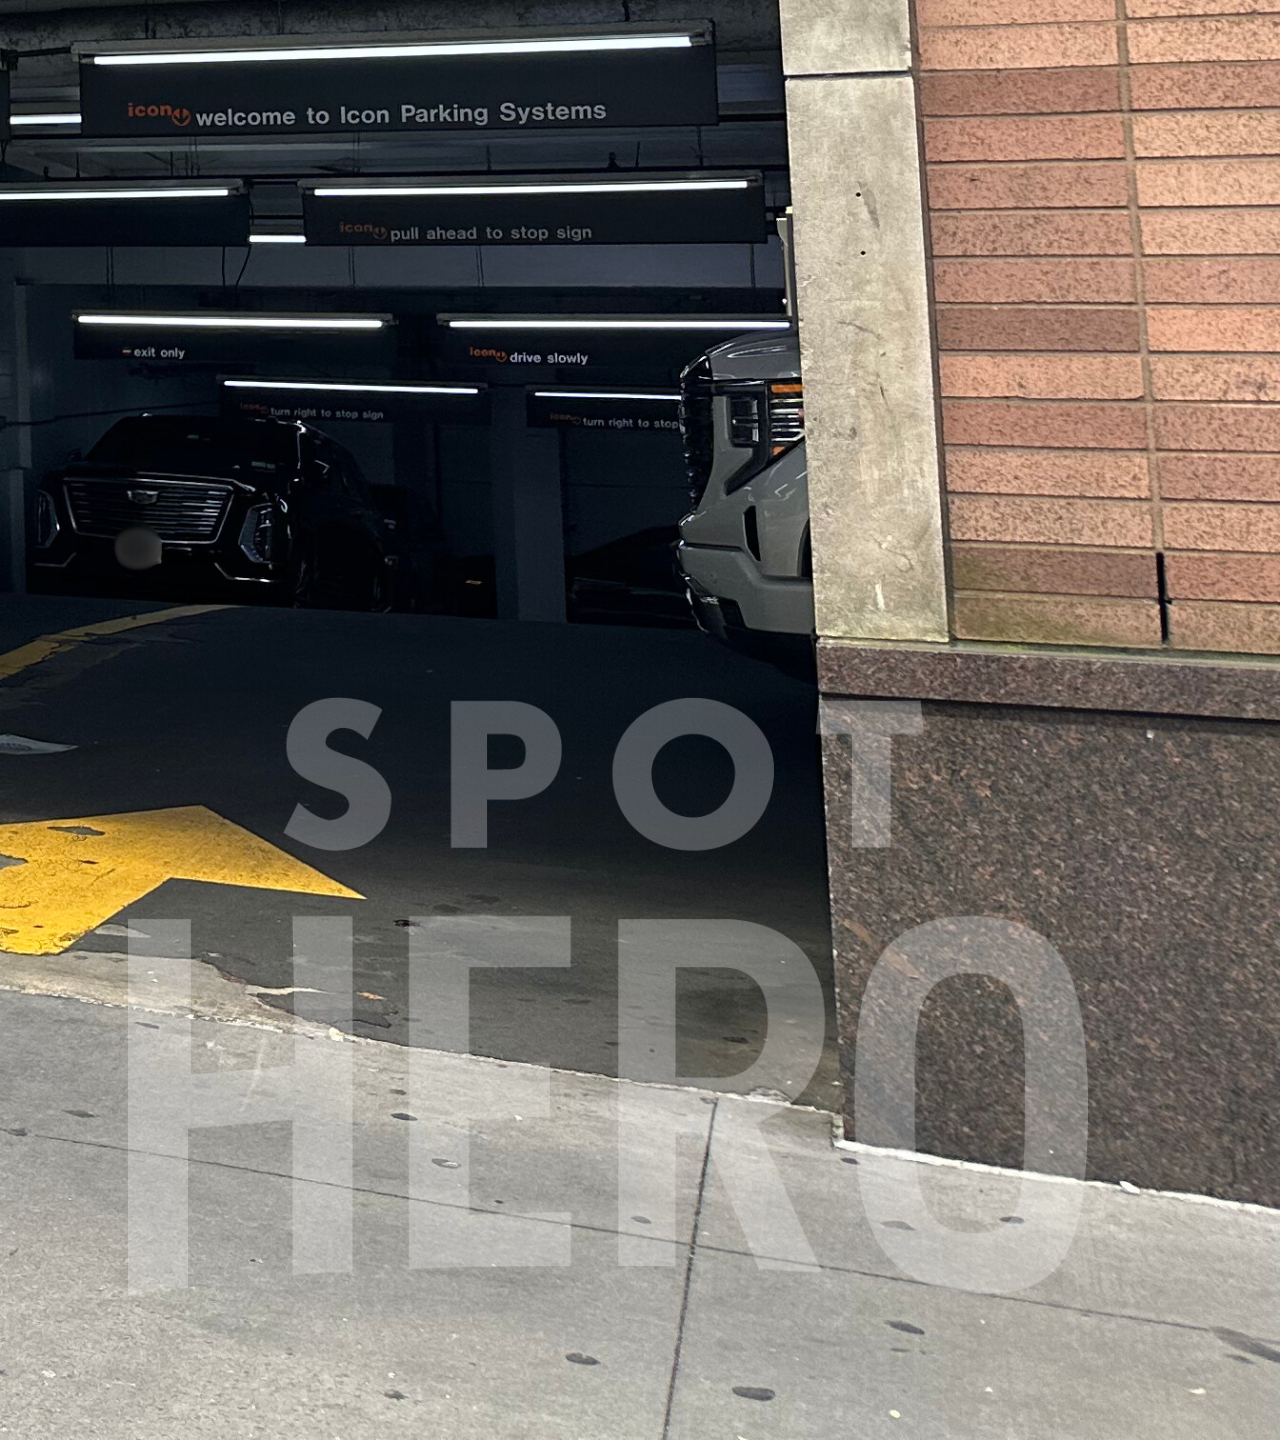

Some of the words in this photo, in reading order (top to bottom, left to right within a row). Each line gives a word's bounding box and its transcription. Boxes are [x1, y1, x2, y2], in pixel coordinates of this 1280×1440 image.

[127, 102, 171, 119] icon
[196, 107, 296, 127] welcome
[306, 108, 330, 126] to
[340, 105, 390, 126] Icon
[400, 103, 488, 129] Parking
[500, 100, 607, 125] Systems
[390, 227, 419, 242] pull
[426, 226, 477, 240] ahead
[486, 226, 503, 239] to
[511, 227, 548, 242] stop
[556, 225, 592, 242] sign
[134, 346, 156, 357] exit
[160, 347, 185, 360] only
[510, 352, 541, 363] drive
[547, 352, 589, 366] slowly
[270, 407, 290, 417] turn
[293, 407, 317, 418] right
[321, 409, 331, 417] to
[335, 409, 358, 420] stop
[362, 410, 384, 420] sign
[582, 417, 605, 427] turn
[608, 417, 633, 429] right
[637, 418, 649, 428] to
[653, 419, 679, 429] stop
